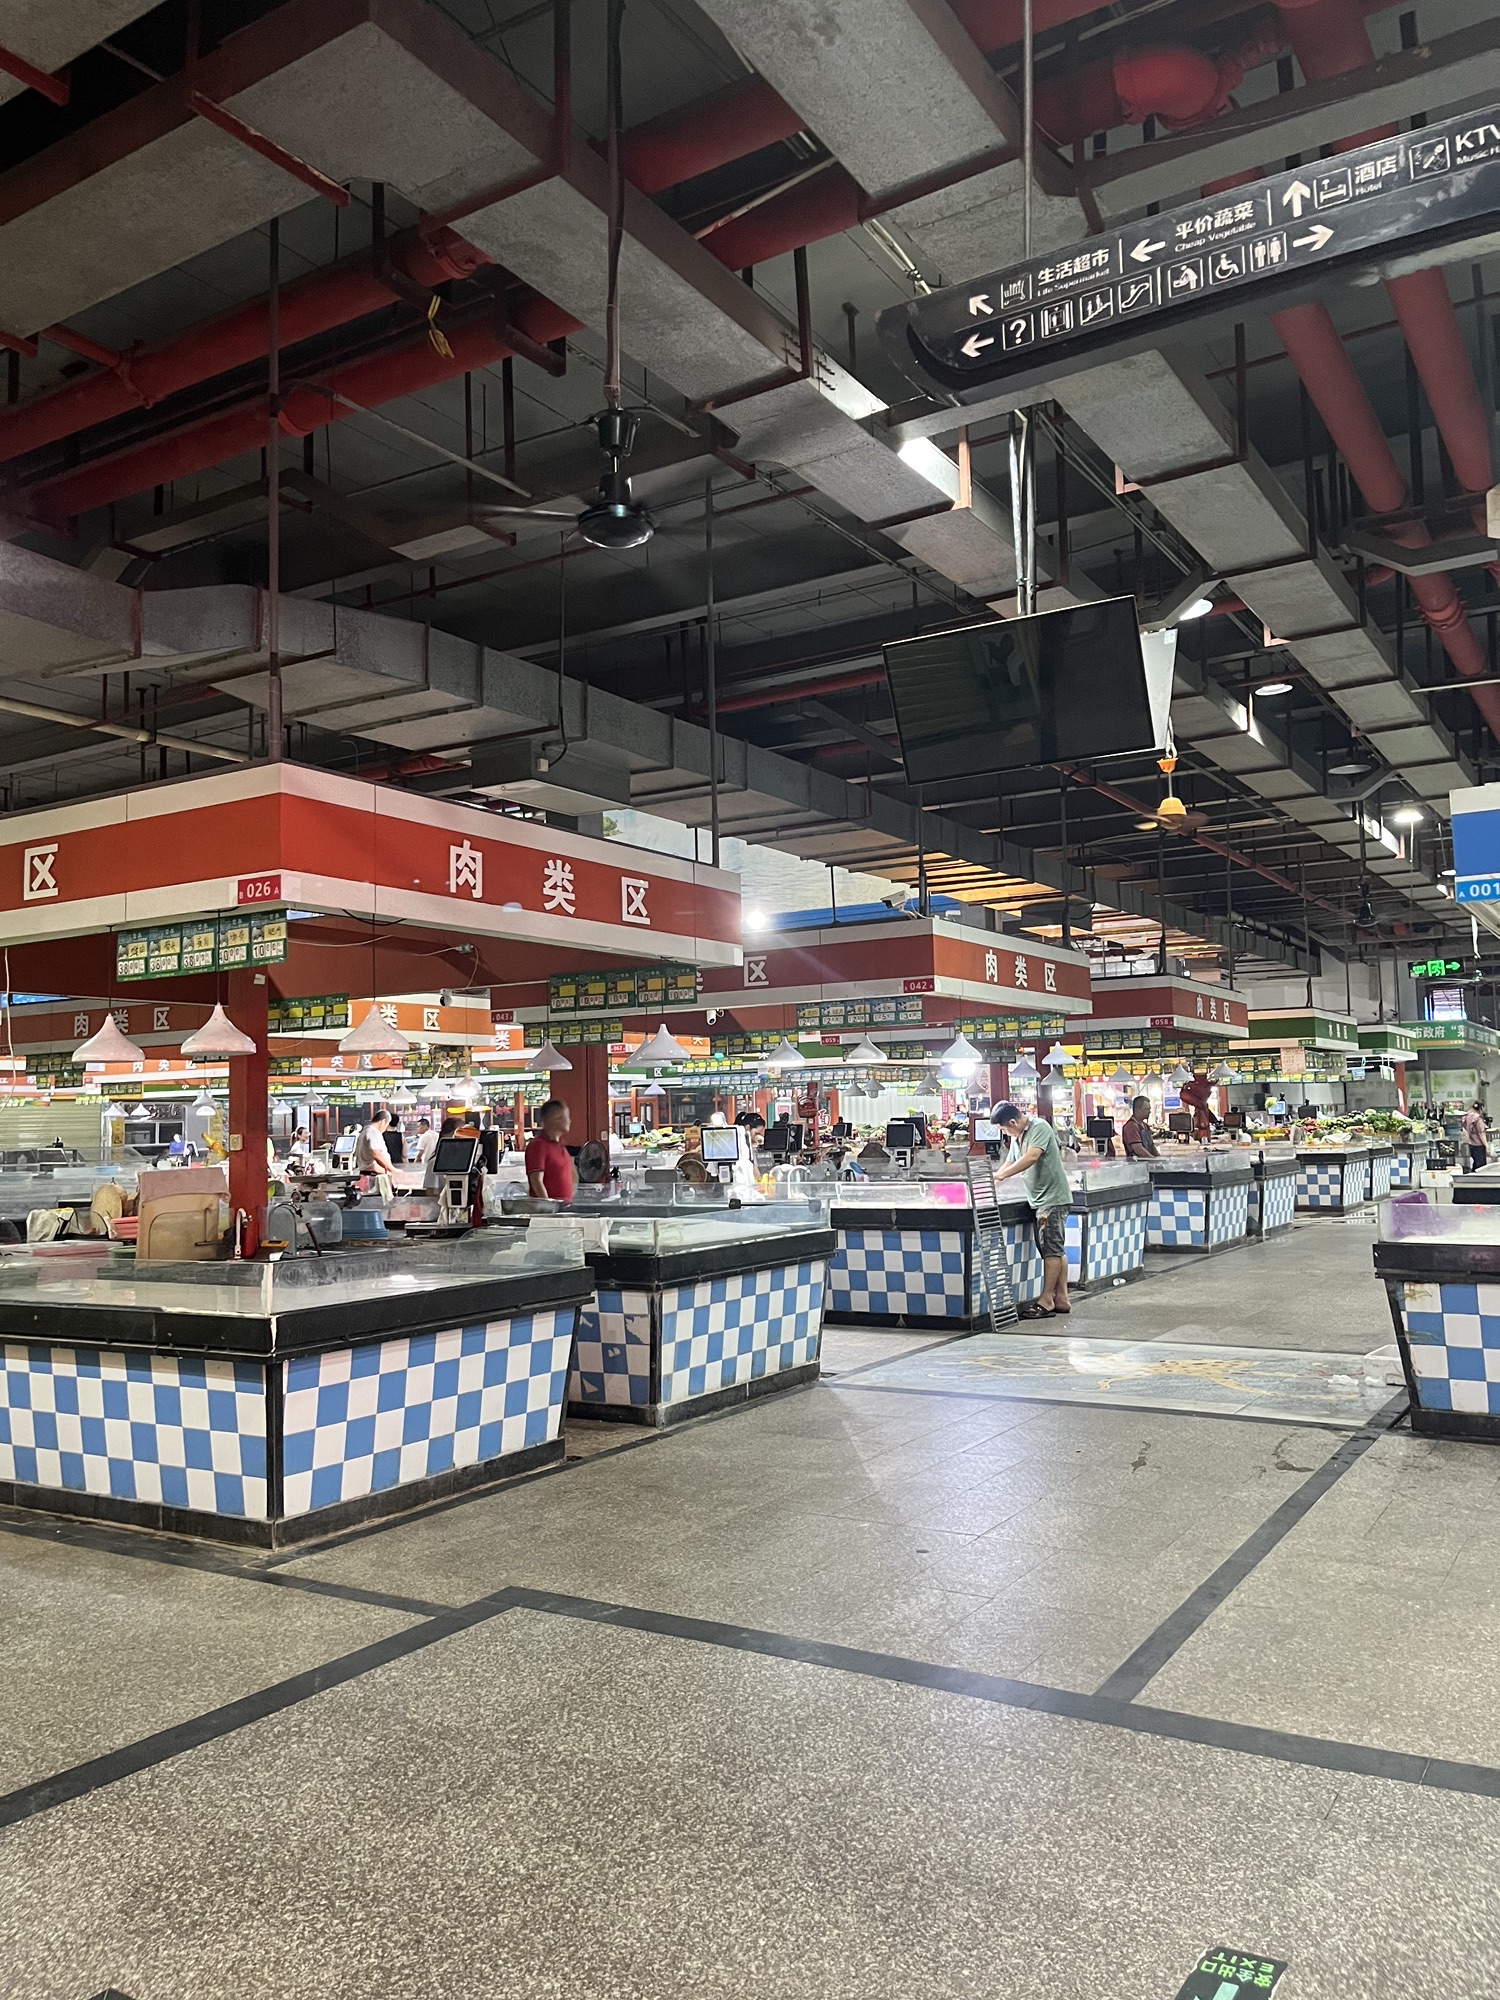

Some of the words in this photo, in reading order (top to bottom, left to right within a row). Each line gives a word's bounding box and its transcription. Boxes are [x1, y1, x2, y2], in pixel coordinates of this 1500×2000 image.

[1355, 155, 1397, 184] 酒店
[1456, 149, 1490, 164] Music
[1355, 181, 1382, 196] Hotel
[1175, 200, 1254, 240] 平价蔬菜
[1175, 238, 1206, 252] Cheap
[1208, 222, 1256, 242] Vegetable
[1037, 248, 1110, 286] 生活超市
[1037, 287, 1054, 298] Life
[1054, 268, 1110, 291] Supermarket
[23, 842, 60, 901] 区
[449, 839, 651, 925] 肉类区
[246, 881, 271, 898] 026
[743, 955, 769, 987] 区
[985, 948, 1057, 992] 肉类区
[909, 981, 928, 991] 042
[495, 1013, 509, 1021] 043
[1154, 1018, 1169, 1026] 058
[1196, 993, 1231, 1022] 肉类区
[1200, 1959, 1274, 1988] 安全出口
[1211, 1952, 1276, 1974] EXIT
